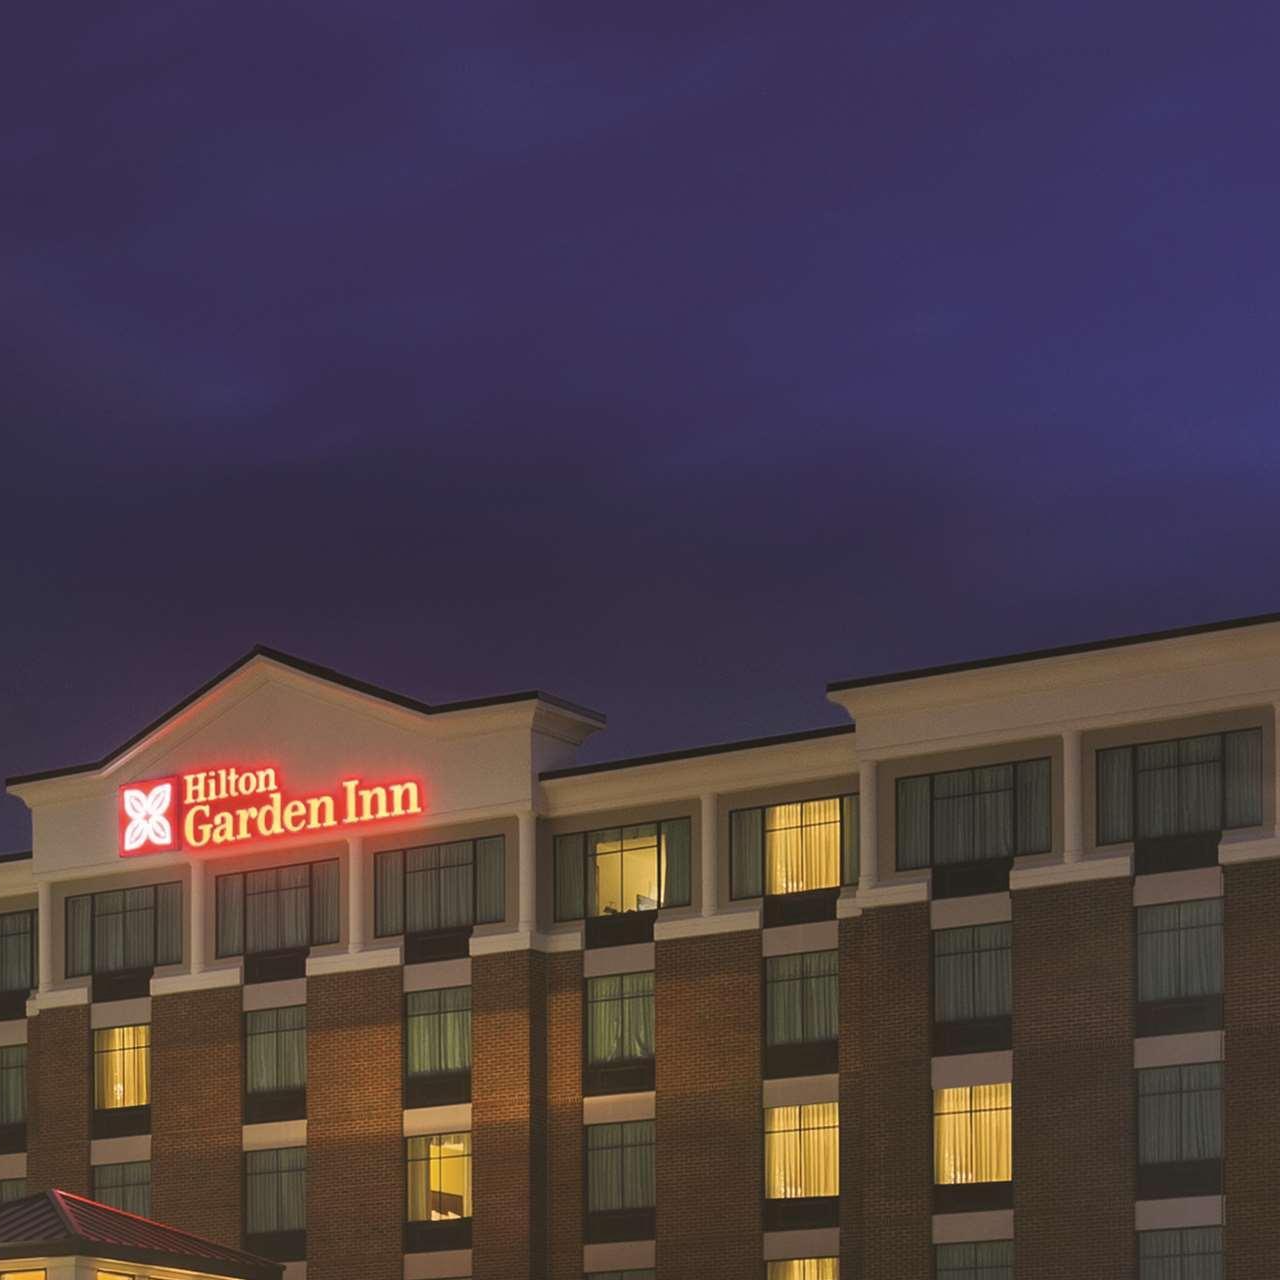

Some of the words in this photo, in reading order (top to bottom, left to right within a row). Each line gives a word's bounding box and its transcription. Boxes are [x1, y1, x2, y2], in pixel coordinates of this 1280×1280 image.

[184, 768, 277, 804] Hilton
[184, 793, 337, 847] Garden
[342, 779, 422, 823] Inn
